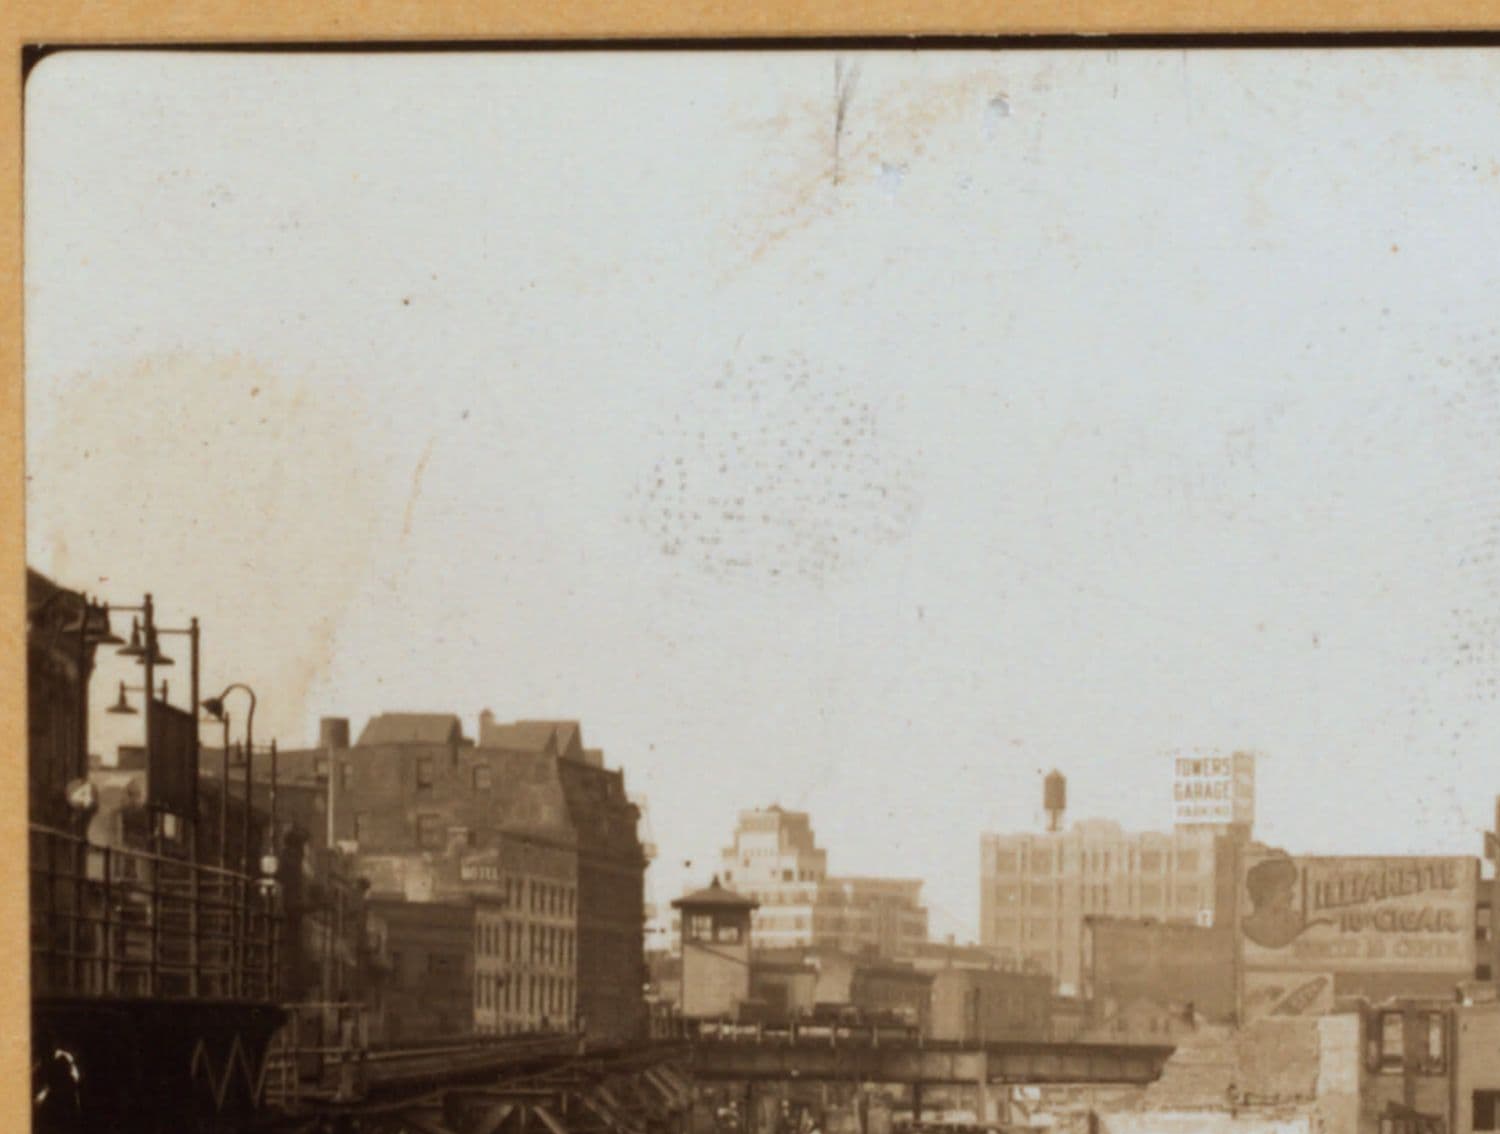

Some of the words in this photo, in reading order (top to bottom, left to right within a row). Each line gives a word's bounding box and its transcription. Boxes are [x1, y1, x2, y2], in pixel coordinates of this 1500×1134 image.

[1175, 758, 1232, 777] TOWERS
[1173, 780, 1231, 801] GARAGE
[1375, 905, 1459, 934] CIGAR
